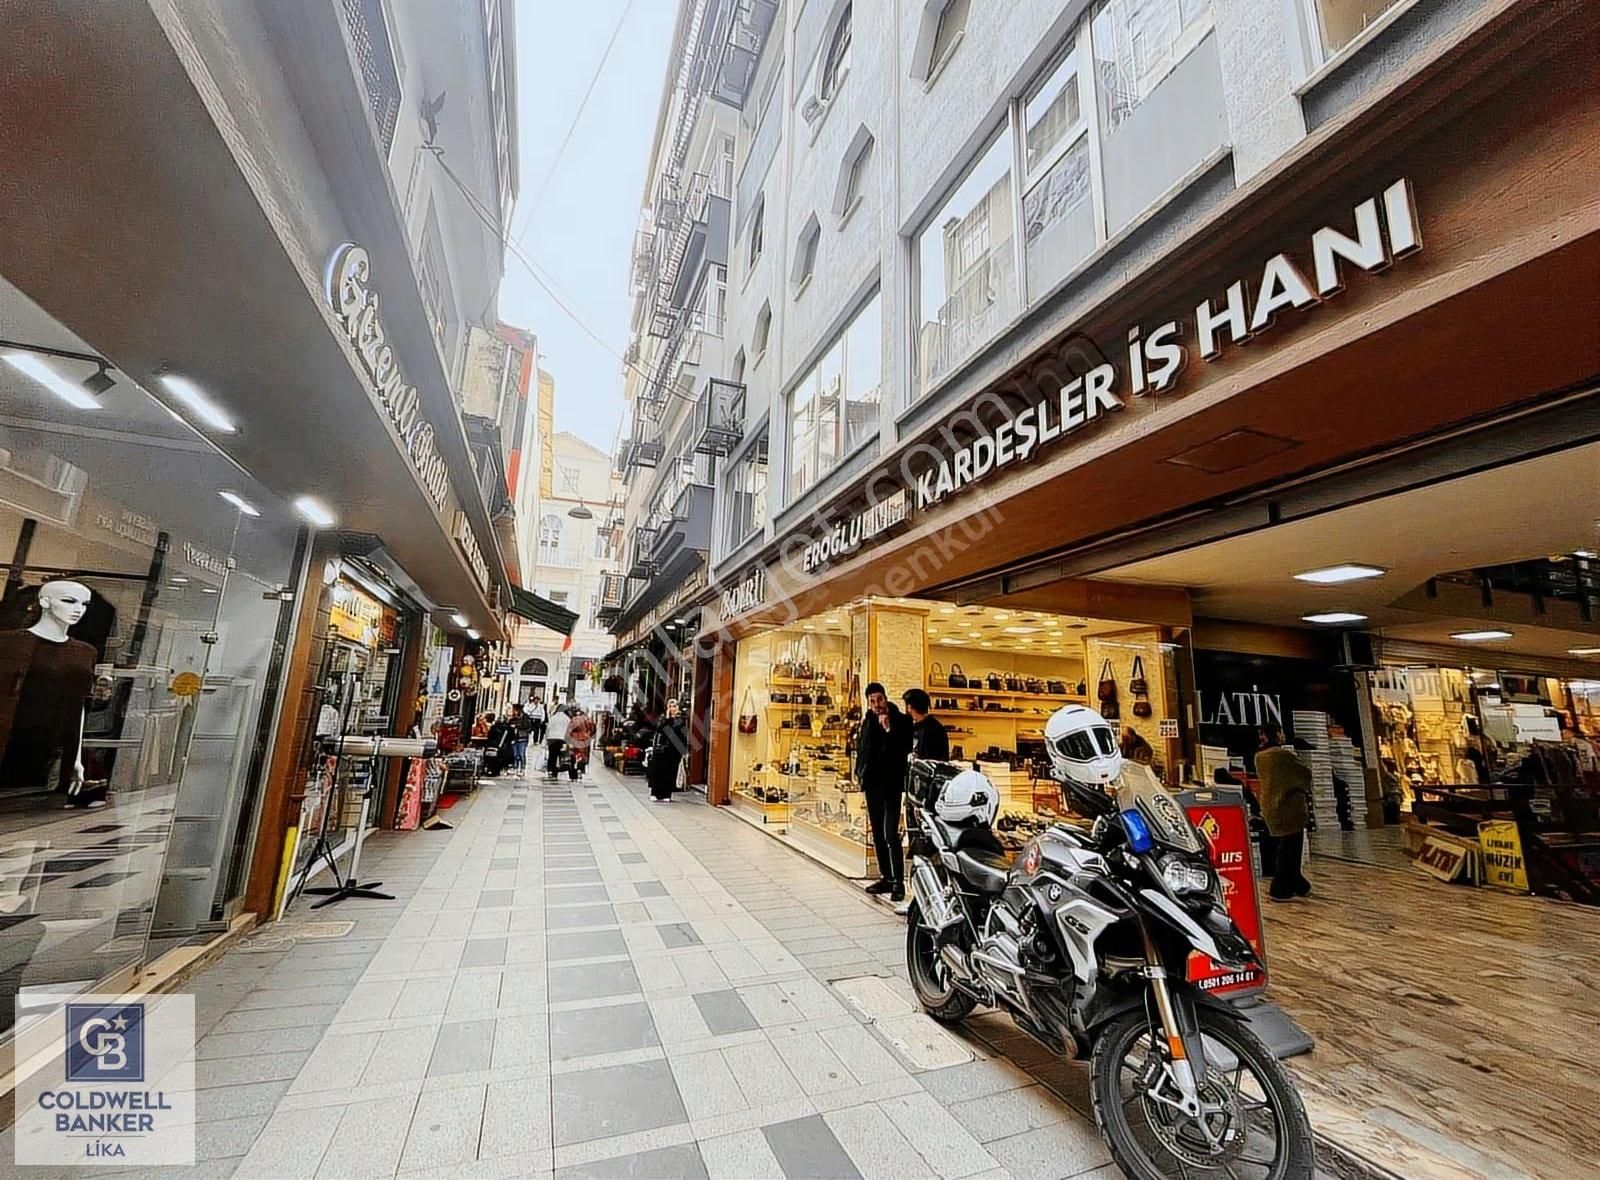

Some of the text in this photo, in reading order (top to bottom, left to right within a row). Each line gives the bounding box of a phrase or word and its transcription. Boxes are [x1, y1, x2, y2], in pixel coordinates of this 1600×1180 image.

[916, 177, 1420, 510] KARDEŞLER İŞ HANI
[803, 514, 862, 573] EROĞLU
[1194, 683, 1284, 727] LATİN
